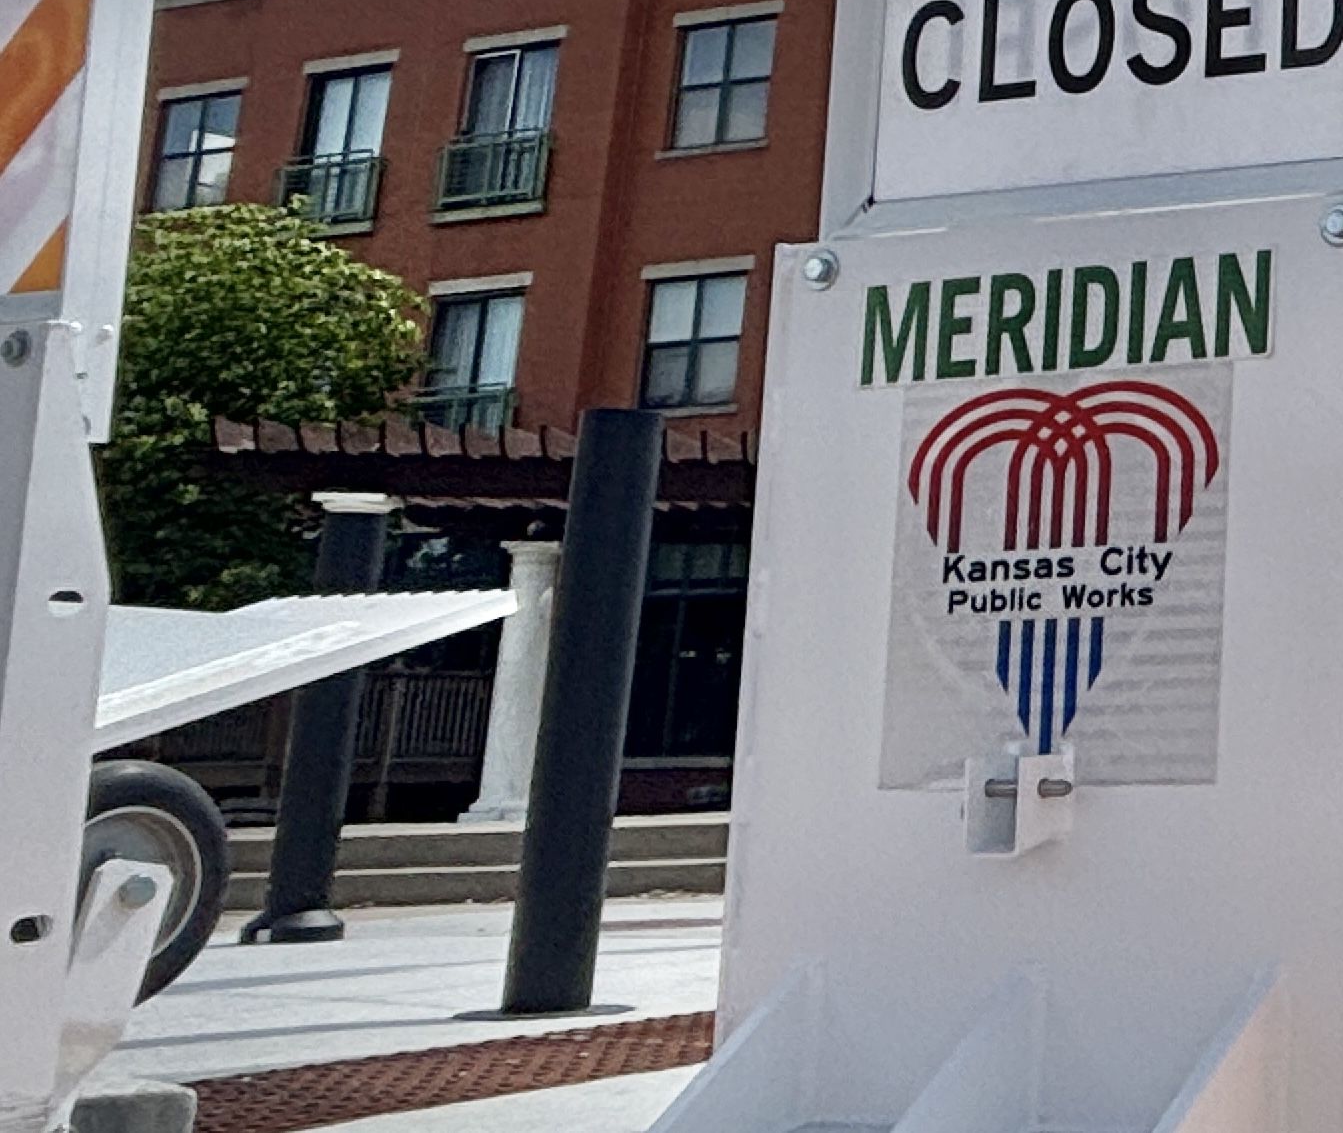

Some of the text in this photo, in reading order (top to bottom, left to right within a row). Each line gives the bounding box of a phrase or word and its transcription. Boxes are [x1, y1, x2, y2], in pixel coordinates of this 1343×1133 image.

[860, 250, 1272, 386] MERIDIAN
[943, 546, 1173, 584] Kansas City
[947, 582, 1154, 615] Public Works
